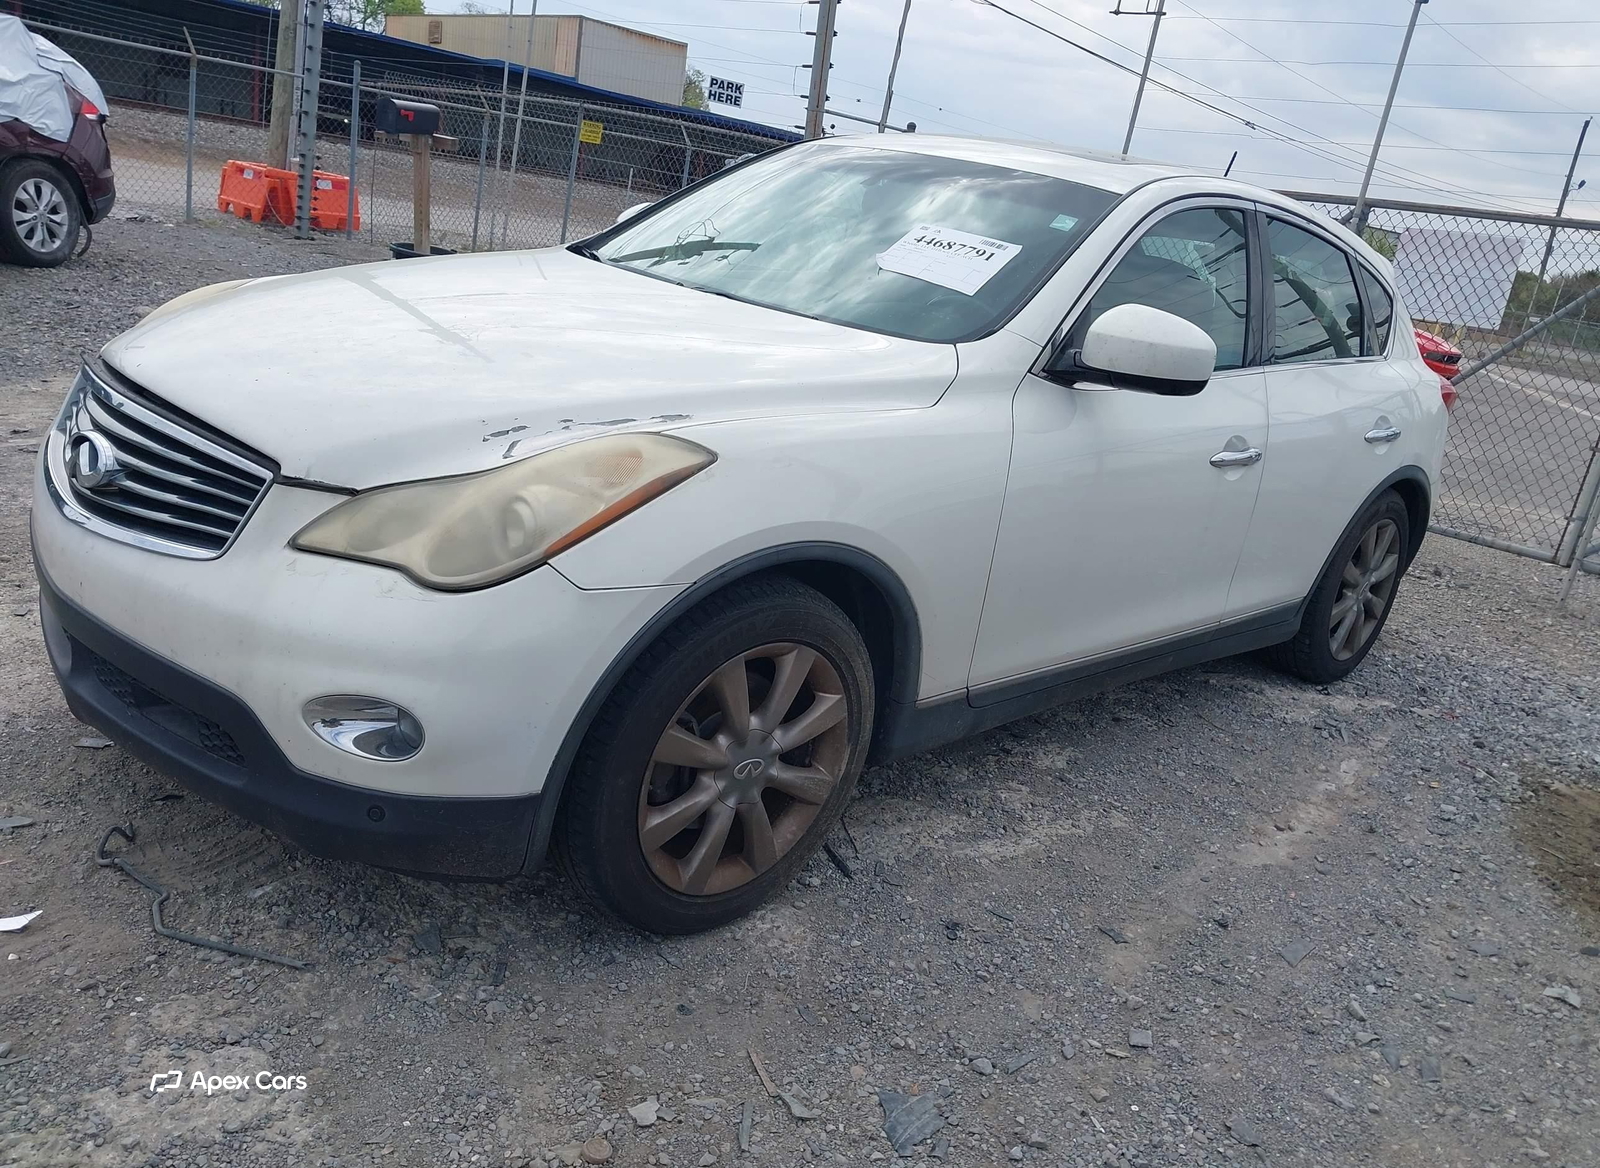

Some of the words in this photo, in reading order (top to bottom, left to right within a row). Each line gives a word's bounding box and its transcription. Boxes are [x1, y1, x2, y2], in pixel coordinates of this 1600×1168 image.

[710, 77, 743, 95] PARK
[708, 89, 742, 106] HERE
[914, 234, 996, 262] 44687791
